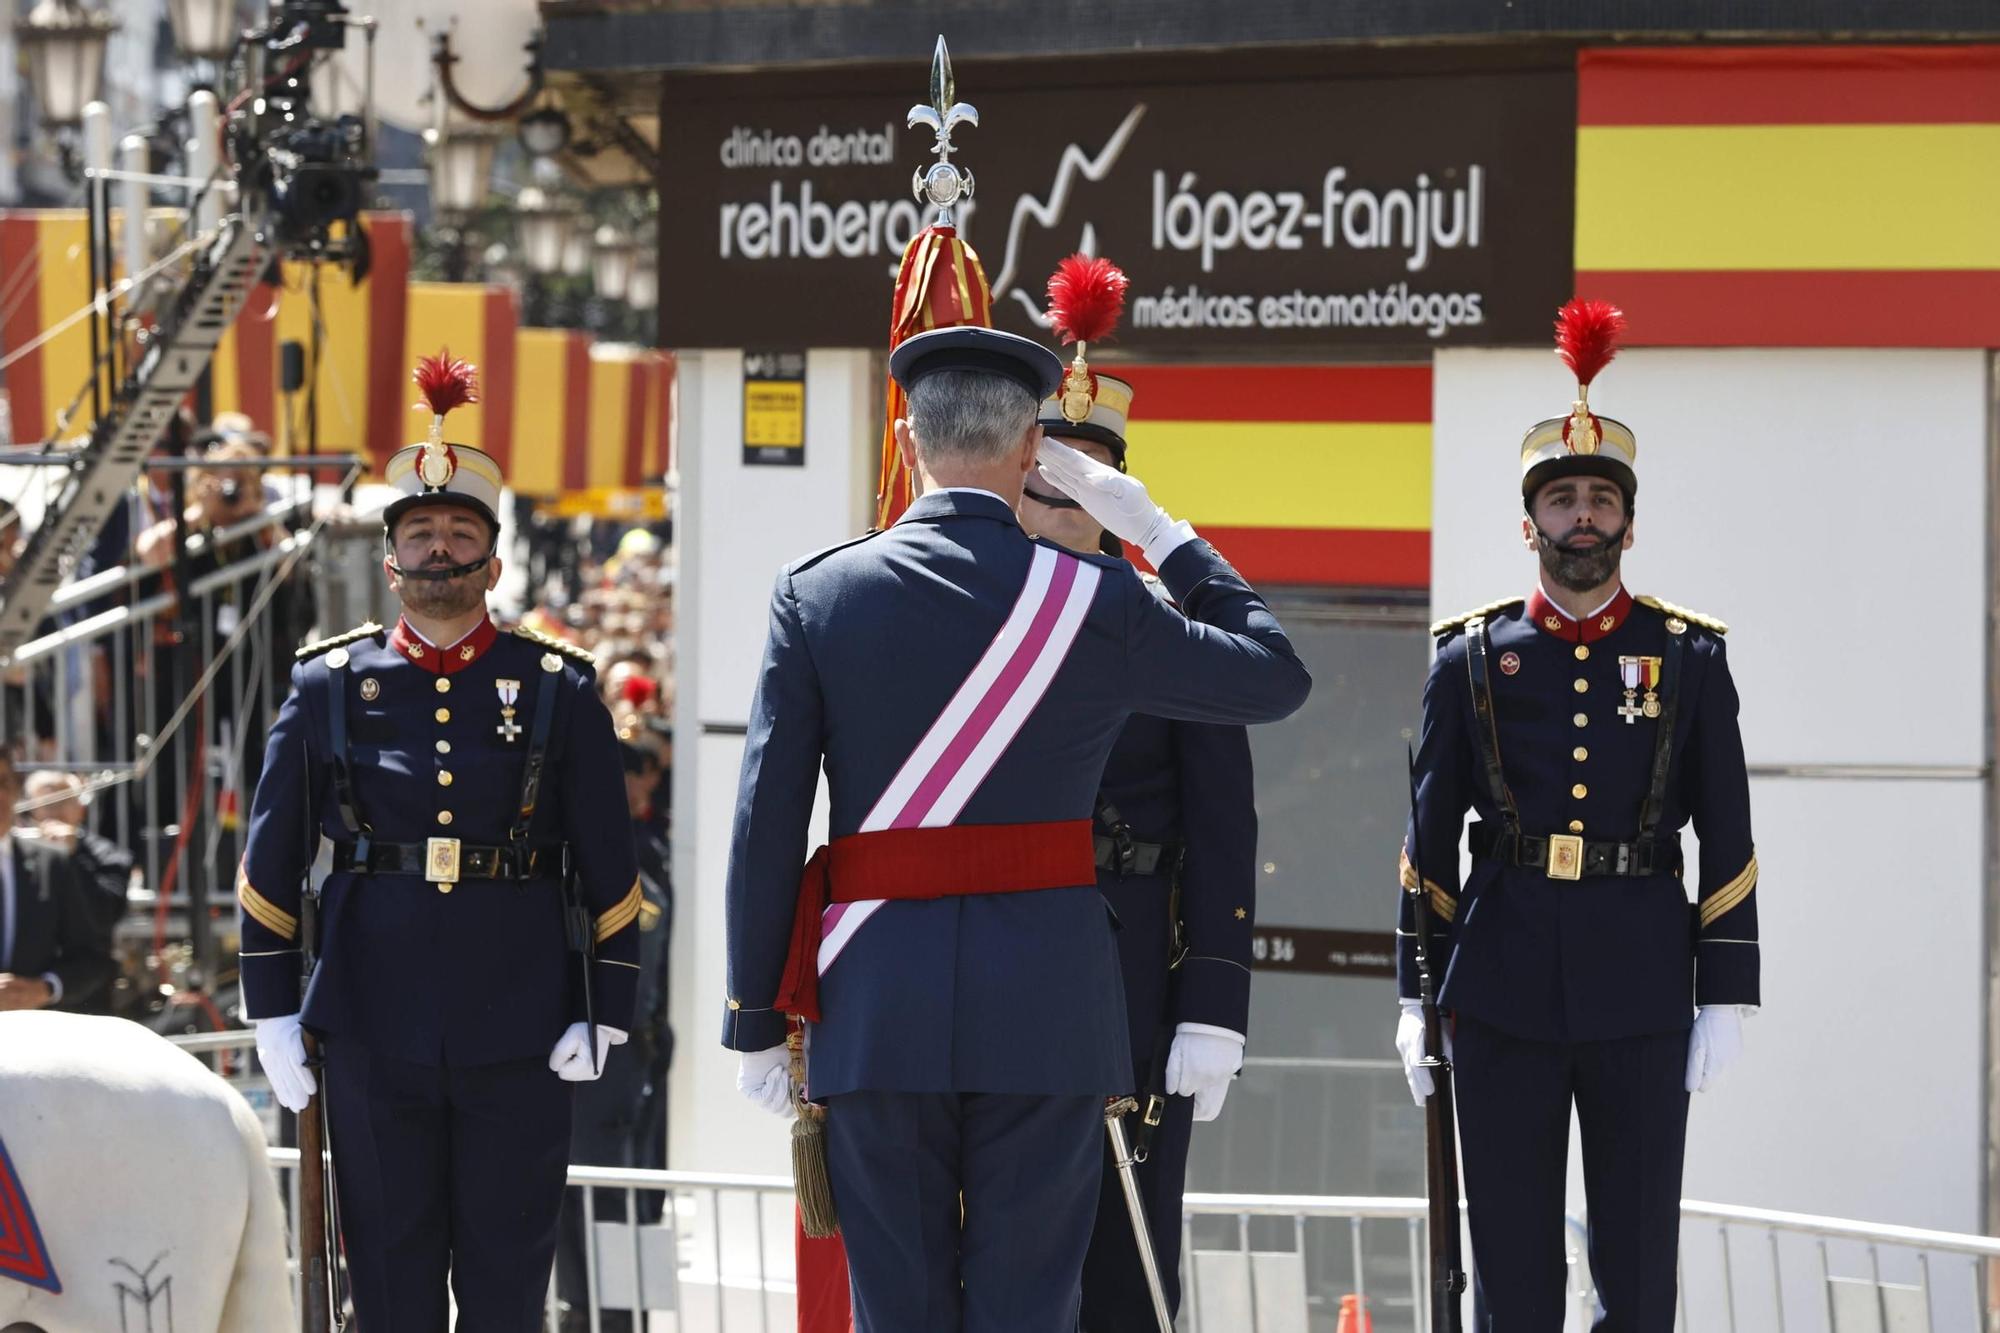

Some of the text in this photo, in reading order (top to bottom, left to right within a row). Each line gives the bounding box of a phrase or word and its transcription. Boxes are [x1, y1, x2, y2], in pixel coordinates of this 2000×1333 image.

[720, 122, 894, 168] clínica dental
[1152, 164, 1481, 272] lópez-fanjul
[1133, 280, 1484, 338] médicos estomatólogos
